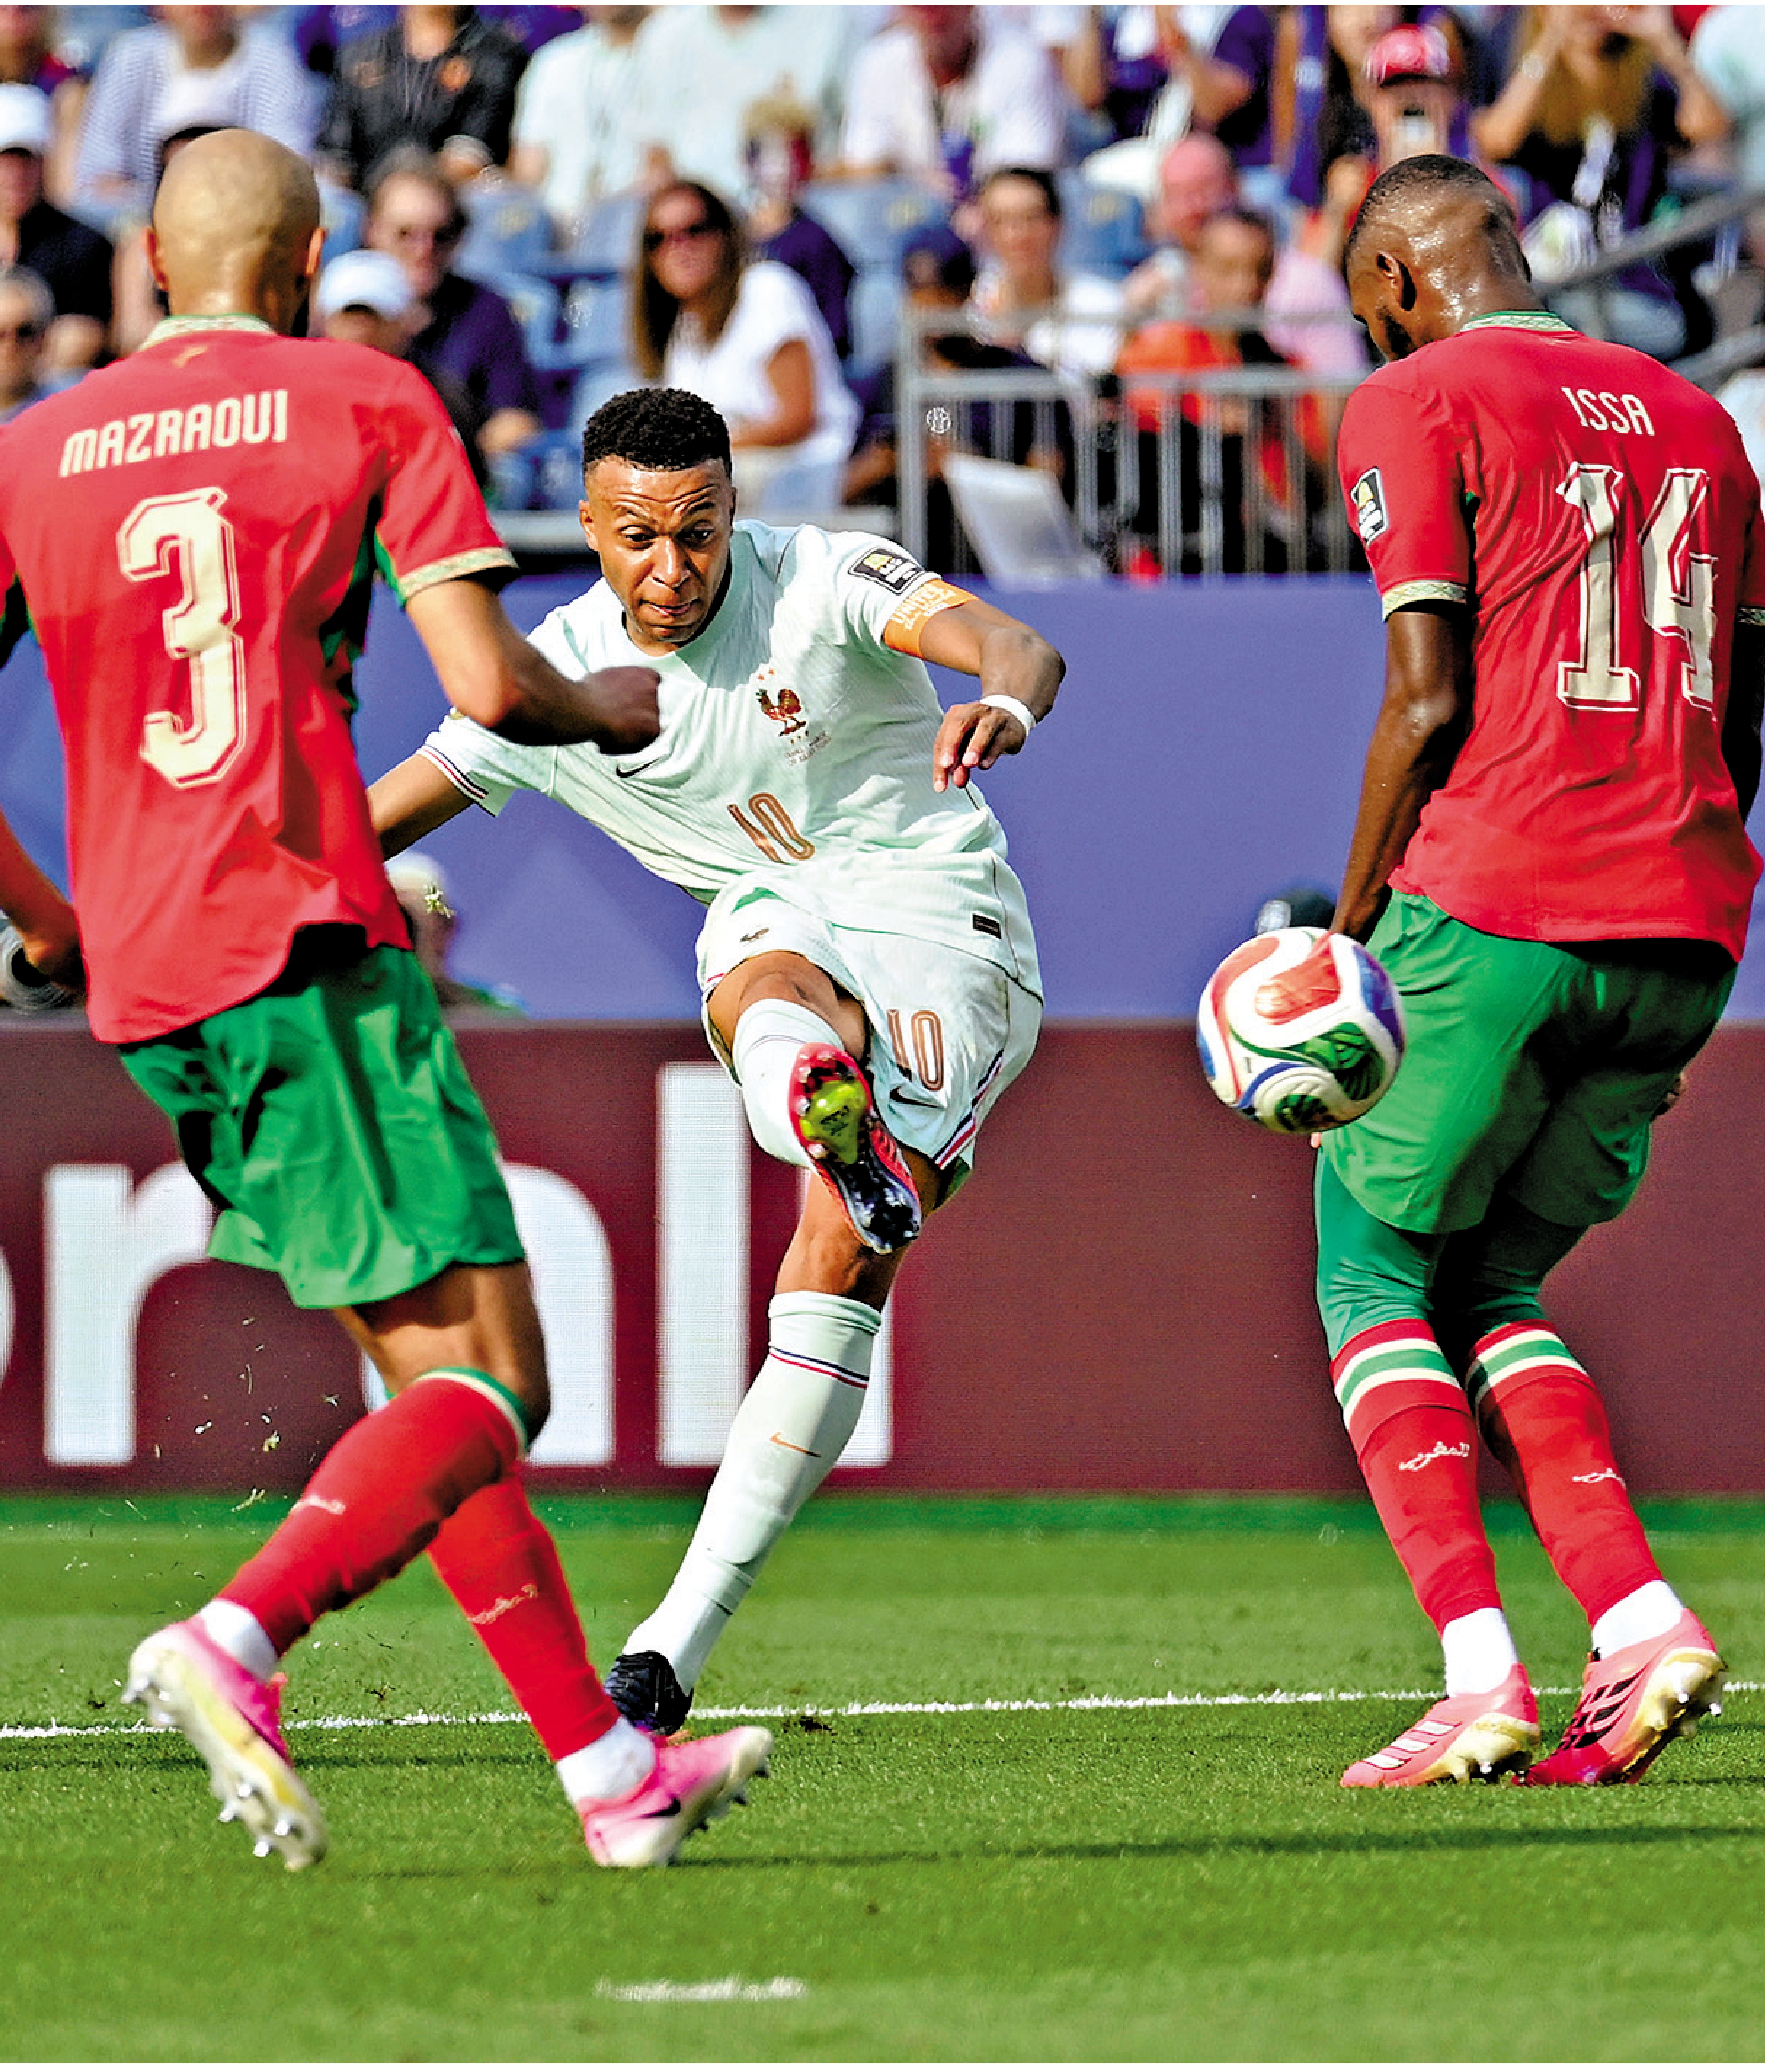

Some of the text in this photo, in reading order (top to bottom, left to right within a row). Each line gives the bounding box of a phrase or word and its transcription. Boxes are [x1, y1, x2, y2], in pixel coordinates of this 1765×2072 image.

[59, 389, 288, 477] MAZRAOUI
[1561, 387, 1656, 437] ISSA
[1555, 461, 1718, 713] 14
[116, 486, 247, 790] 3
[727, 792, 815, 864] 10
[886, 1009, 944, 1091] 10
